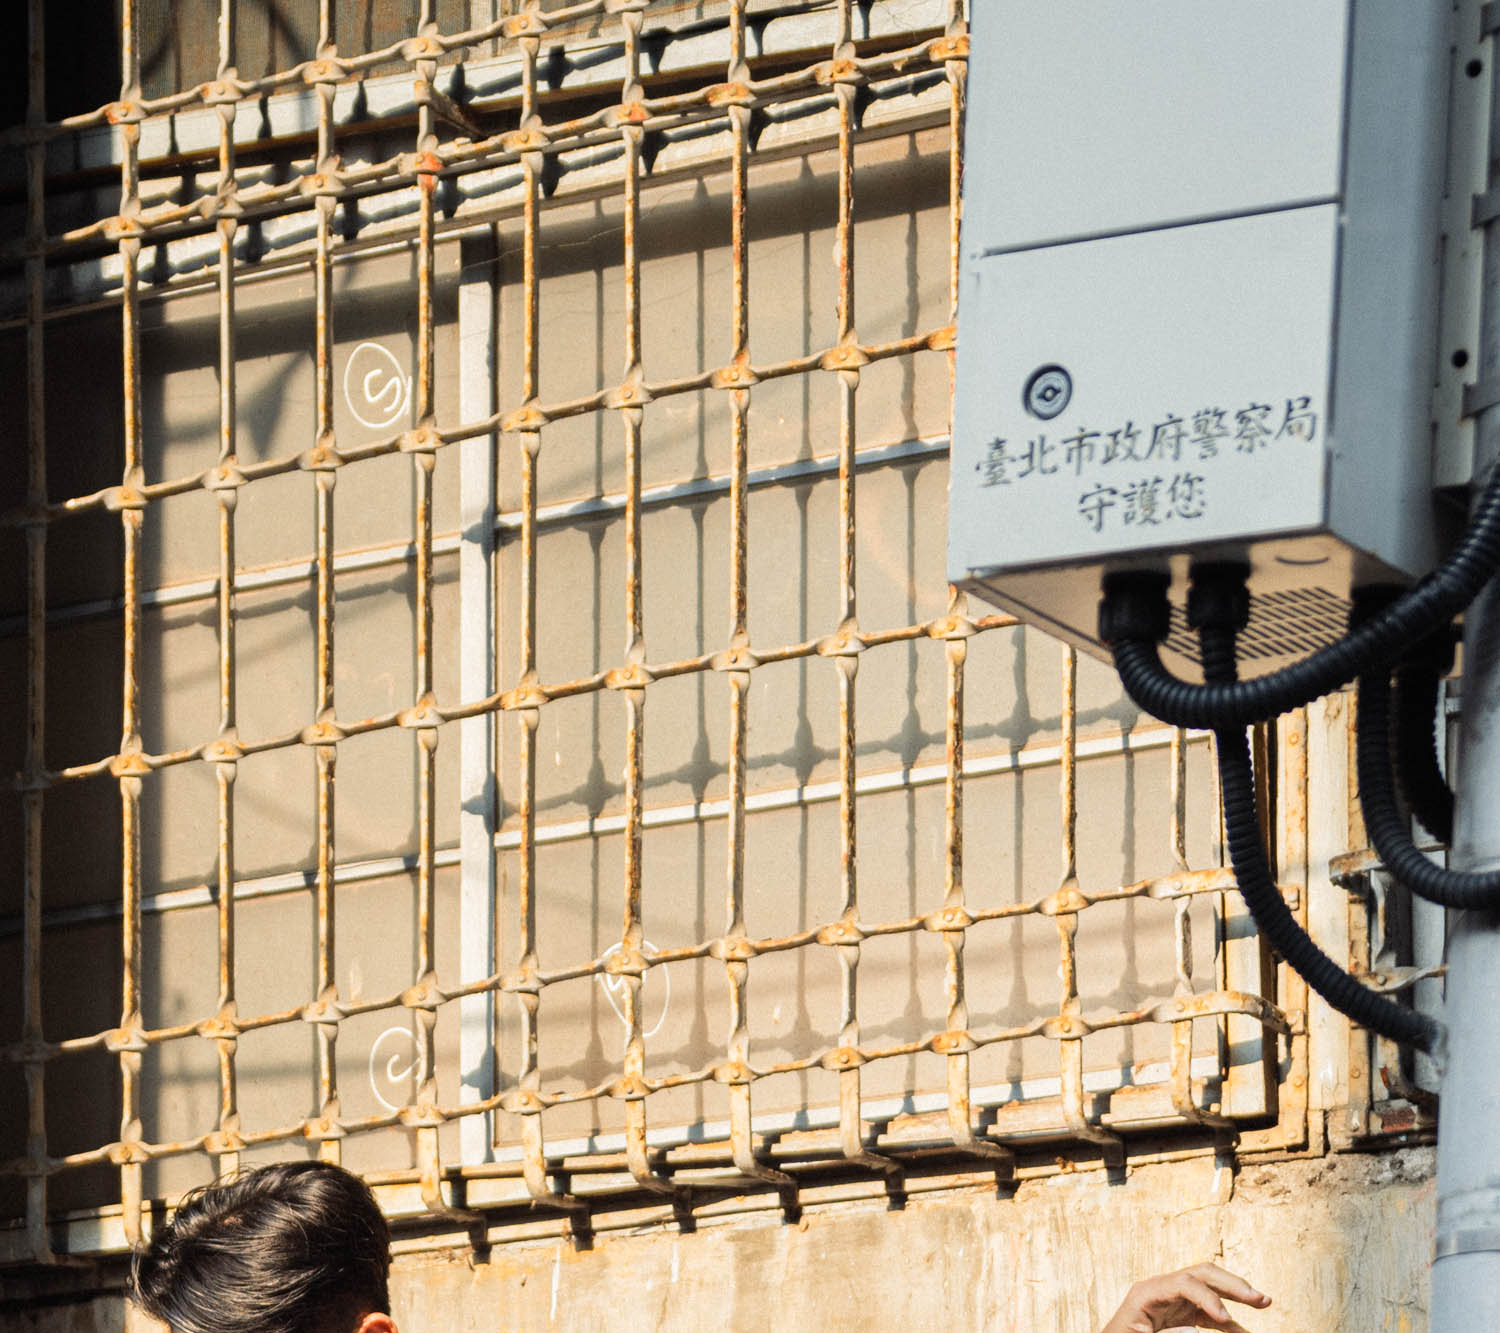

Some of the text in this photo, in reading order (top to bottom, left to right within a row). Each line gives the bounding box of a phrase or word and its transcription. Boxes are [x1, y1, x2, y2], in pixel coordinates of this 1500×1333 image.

[974, 396, 1317, 488] 臺北市政府警察局
[1078, 472, 1206, 533] 守護您
